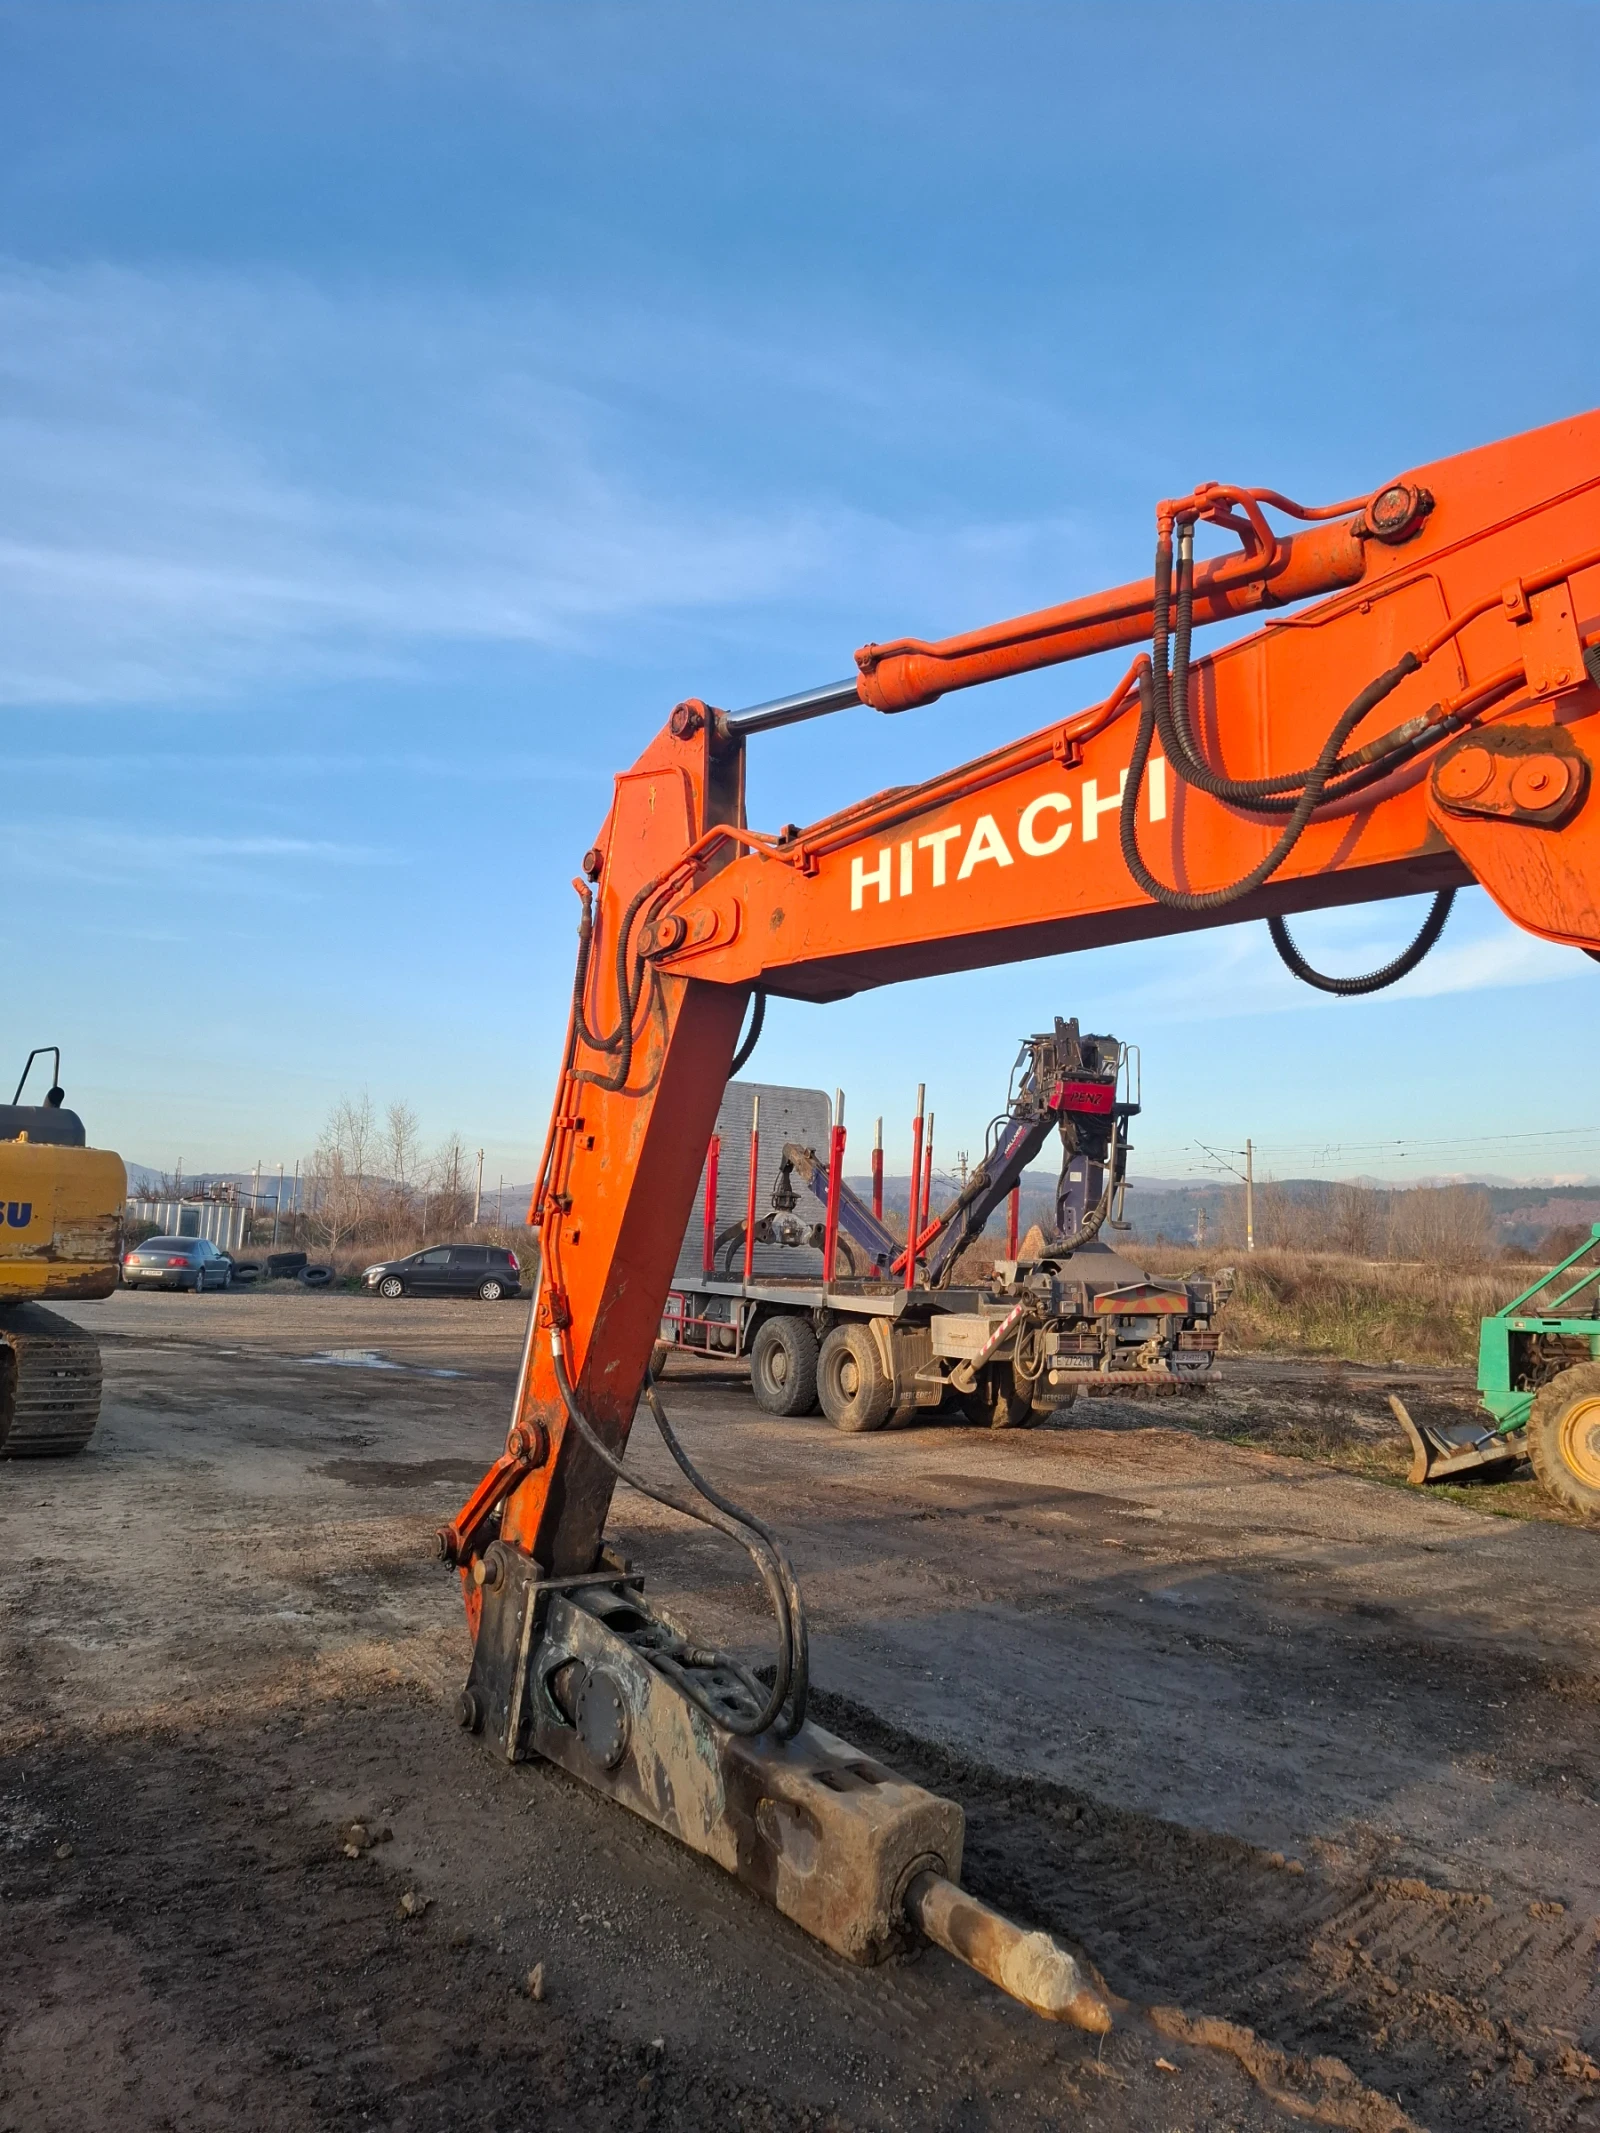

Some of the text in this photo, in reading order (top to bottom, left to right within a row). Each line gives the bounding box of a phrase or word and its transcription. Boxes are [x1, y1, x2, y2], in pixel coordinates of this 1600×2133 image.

[850, 756, 1167, 911] HITACHI
[1070, 1092, 1103, 1104] PENZ
[0, 1202, 32, 1228] U
[900, 1391, 933, 1400] MERCEDES
[1041, 1394, 1071, 1402] MERCEDES
